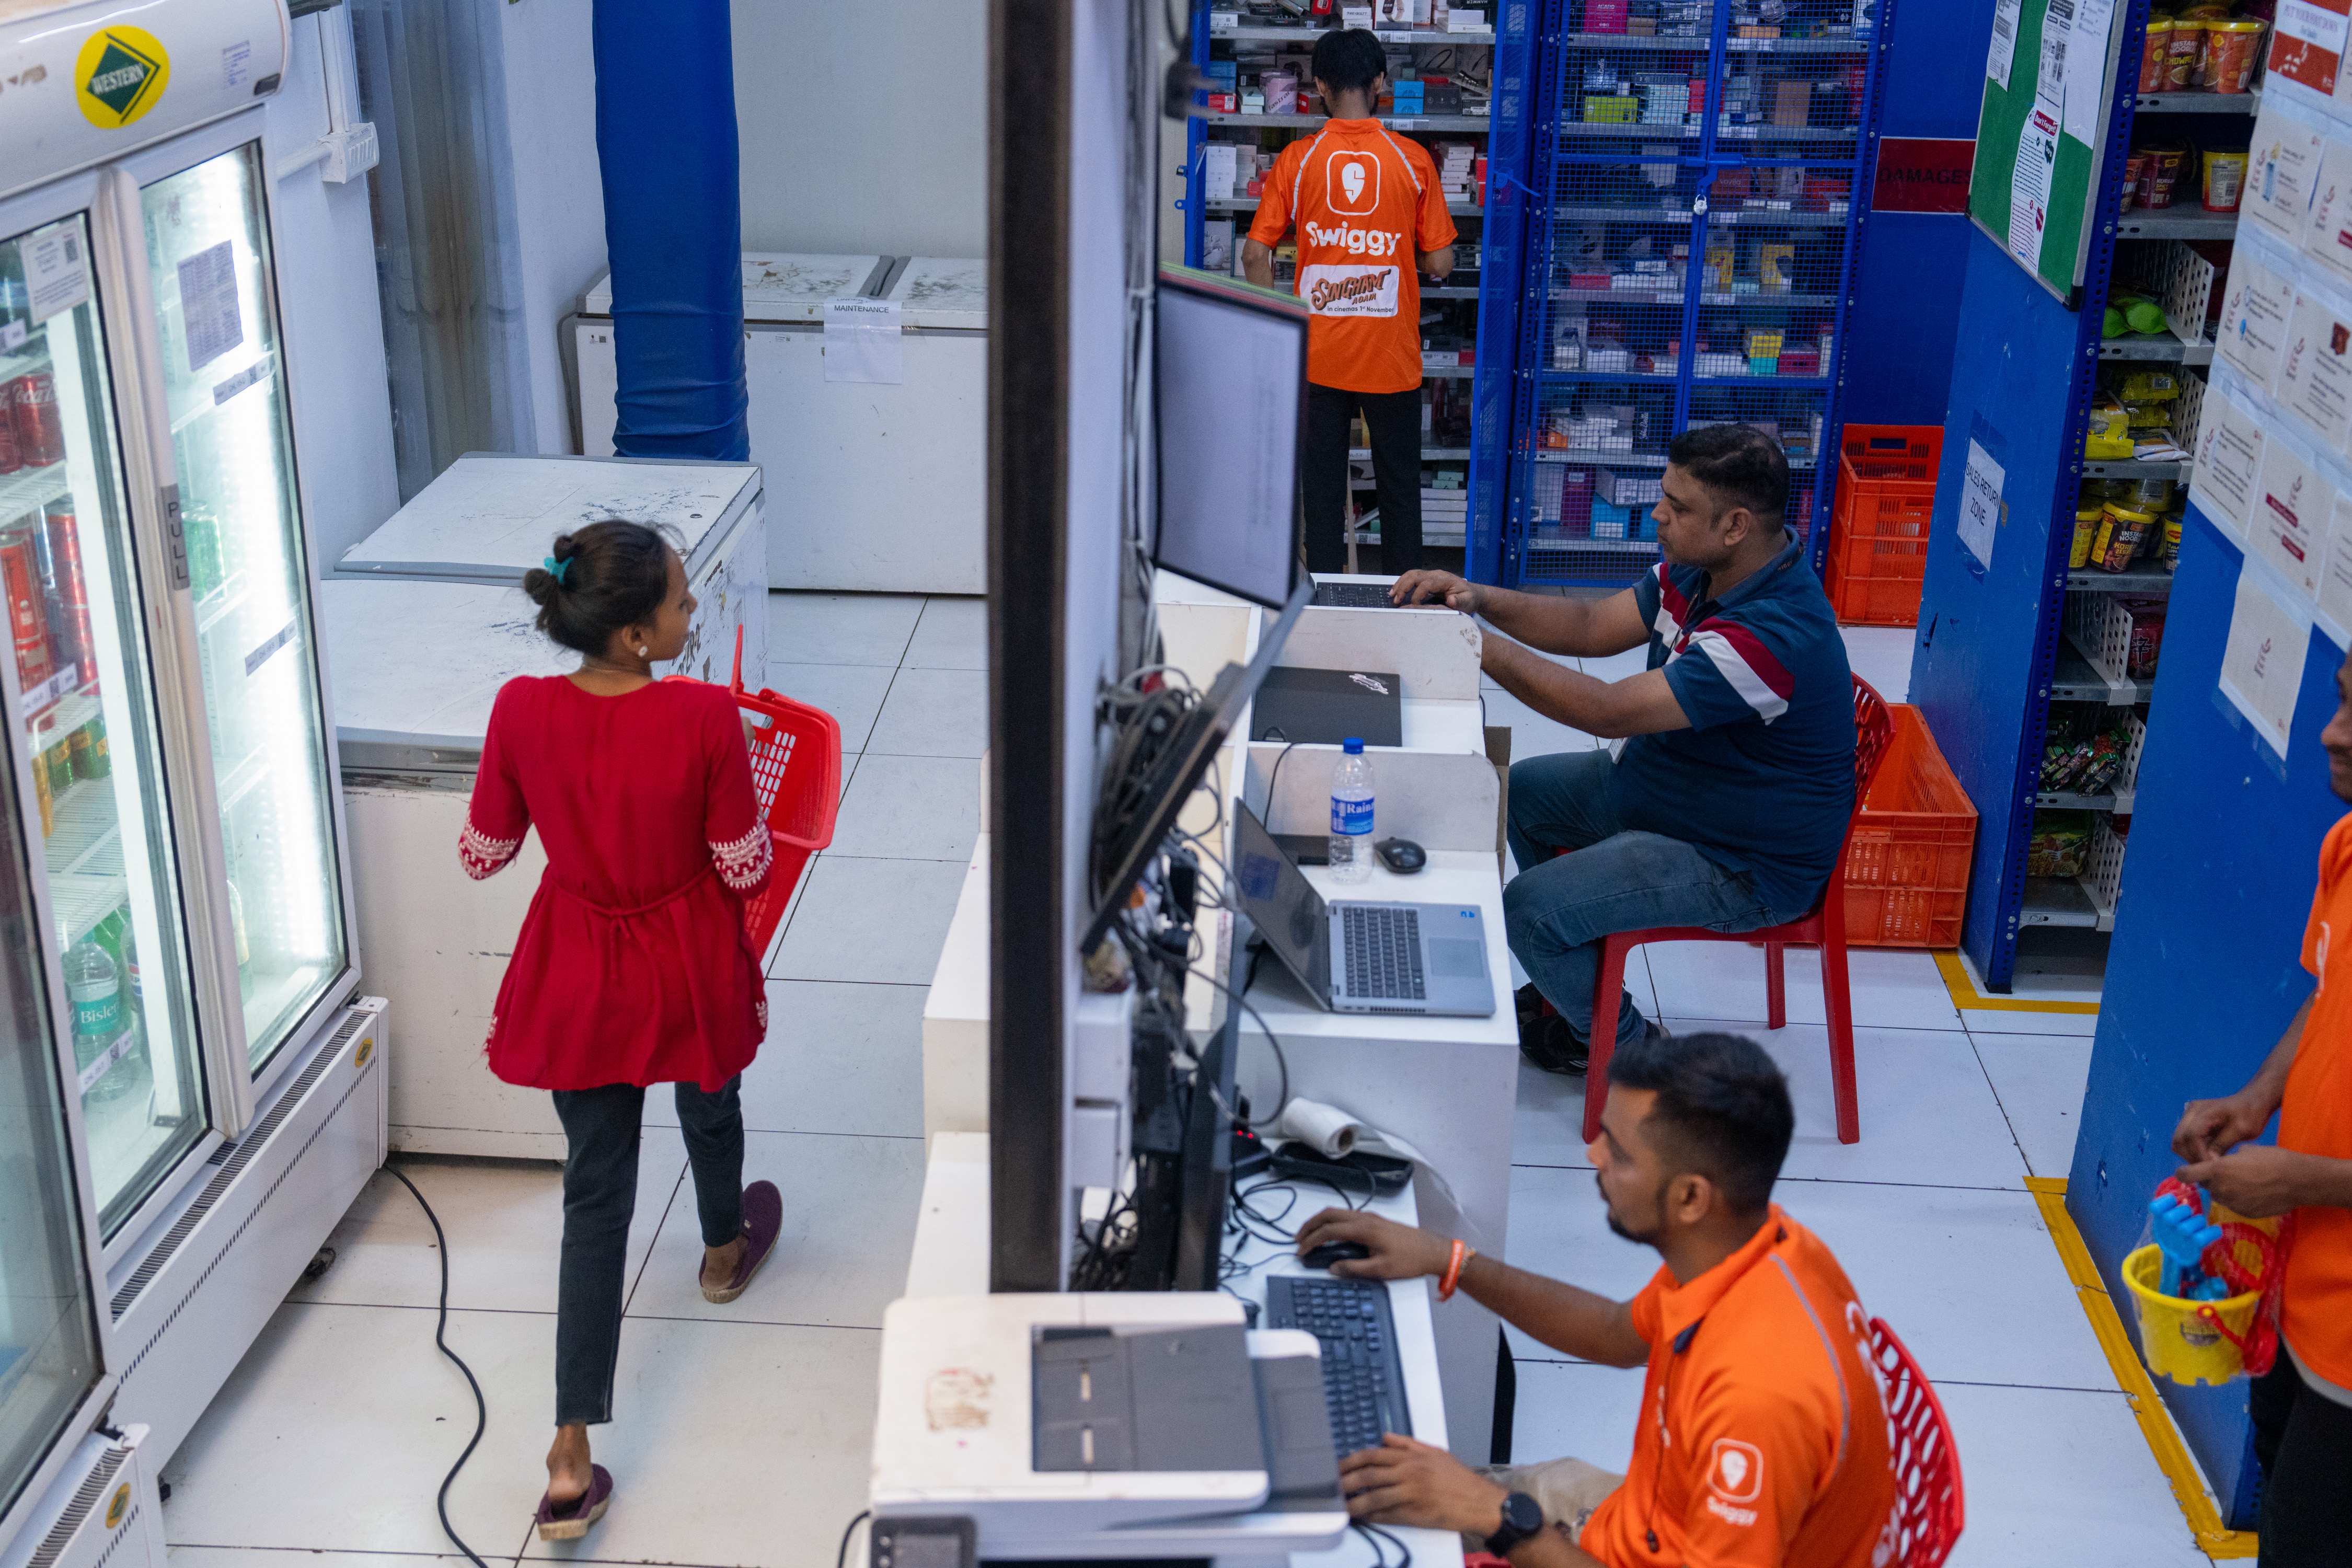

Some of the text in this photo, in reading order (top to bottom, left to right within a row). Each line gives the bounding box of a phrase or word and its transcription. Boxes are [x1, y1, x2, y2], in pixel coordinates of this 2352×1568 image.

[2035, 114, 2056, 133] Don't Forget!
[1306, 221, 1401, 256] Swiggy
[1311, 268, 1391, 310] SINGHAM
[1352, 293, 1377, 305] AGAIN
[834, 305, 889, 313] MAINTENANCE
[1966, 462, 2001, 510] SALES RETURN
[1970, 497, 1986, 527] ZONE
[168, 502, 188, 580] PULL
